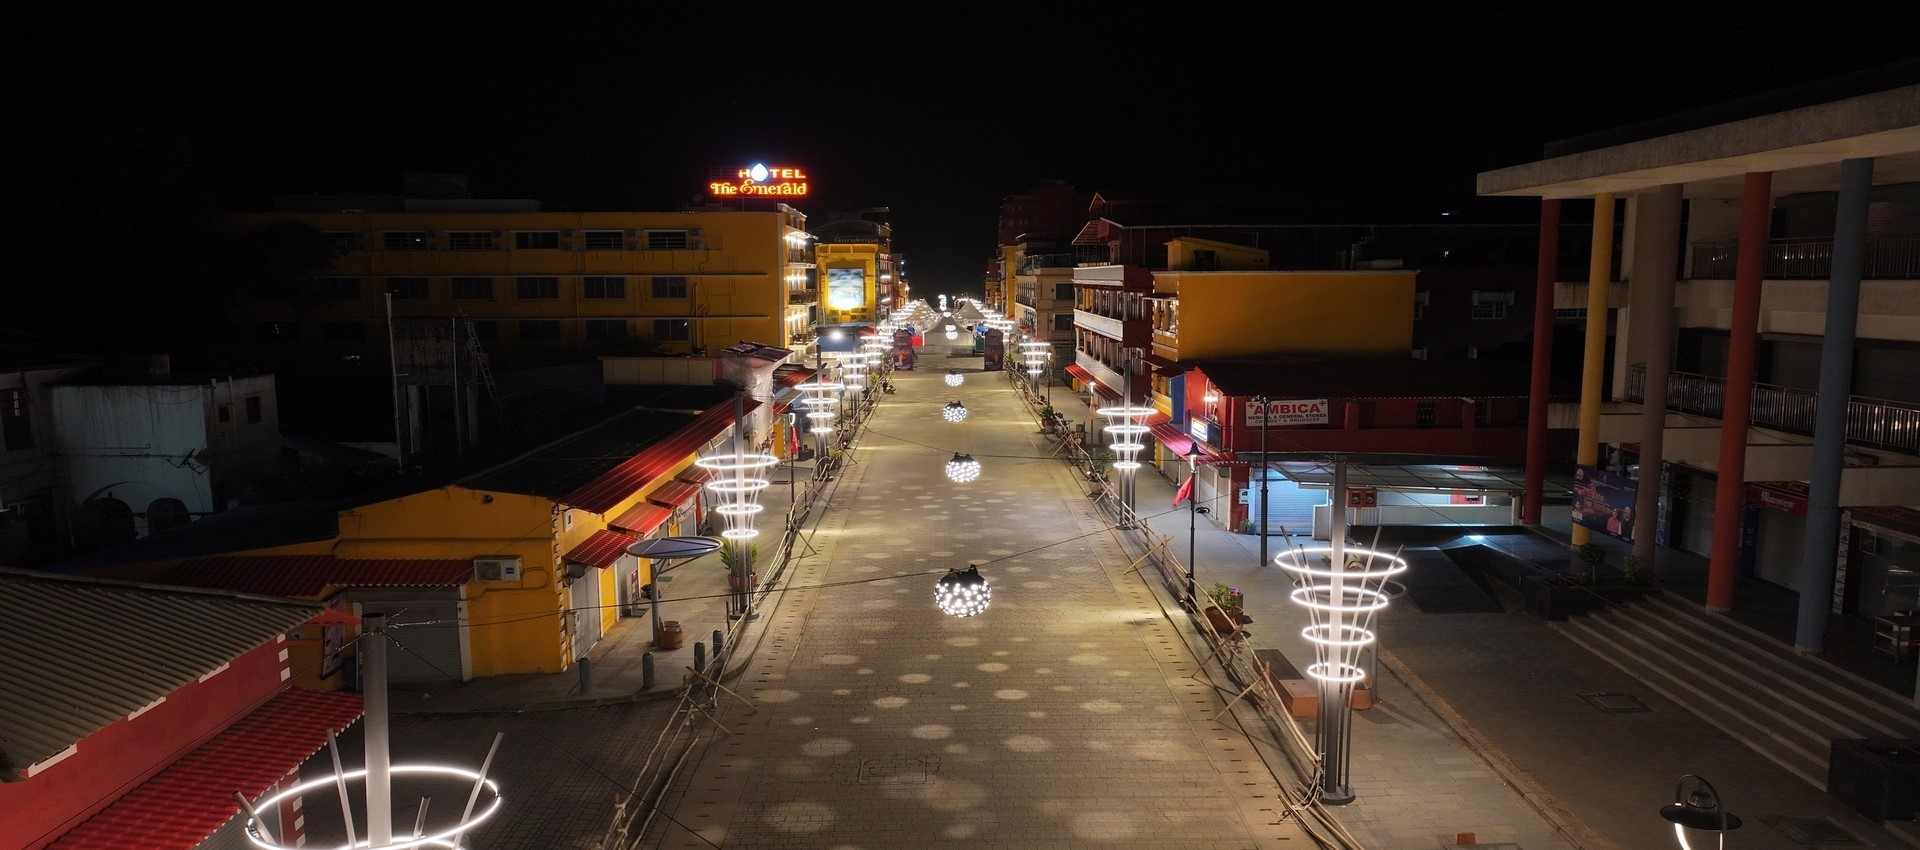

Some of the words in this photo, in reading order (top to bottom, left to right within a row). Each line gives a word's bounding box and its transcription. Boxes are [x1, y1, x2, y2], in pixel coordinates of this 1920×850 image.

[738, 164, 806, 181] HOTEL
[710, 183, 738, 195] The
[740, 179, 807, 195] Emerald
[1254, 403, 1321, 415] AMBICA
